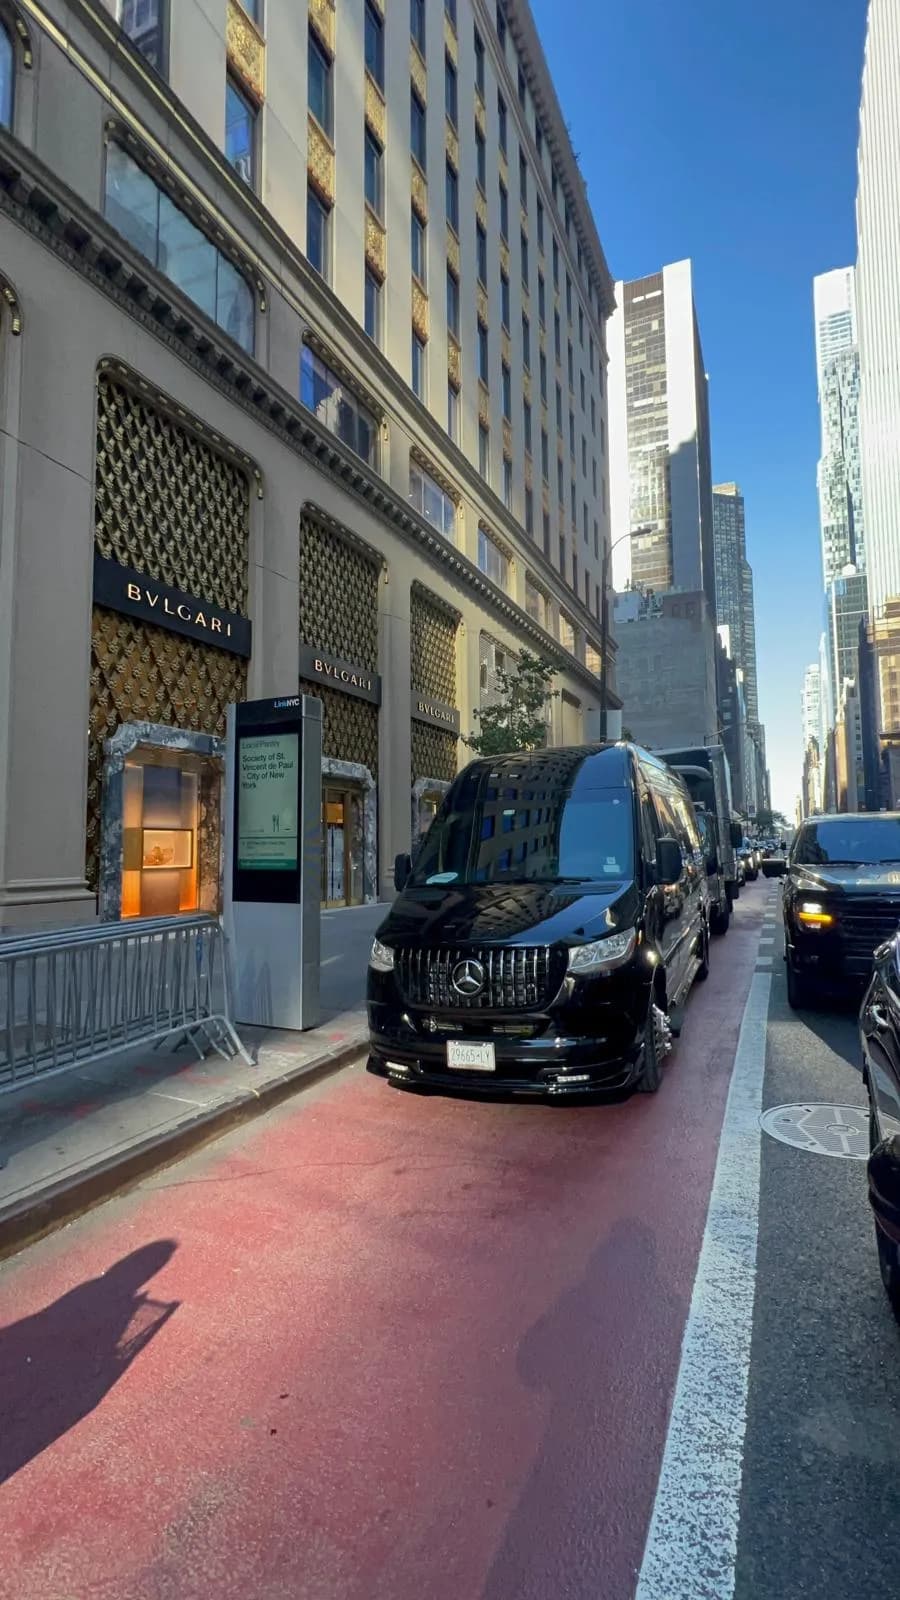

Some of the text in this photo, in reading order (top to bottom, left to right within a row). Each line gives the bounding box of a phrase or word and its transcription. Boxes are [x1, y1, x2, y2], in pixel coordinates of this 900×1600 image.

[127, 583, 231, 637] BVLGARI
[314, 659, 371, 691] BVLGARI
[418, 702, 455, 724] BVLGARI
[268, 753, 275, 761] of
[268, 762, 277, 770] de
[278, 761, 294, 769] Paul
[261, 771, 268, 779] of
[269, 770, 284, 779] New
